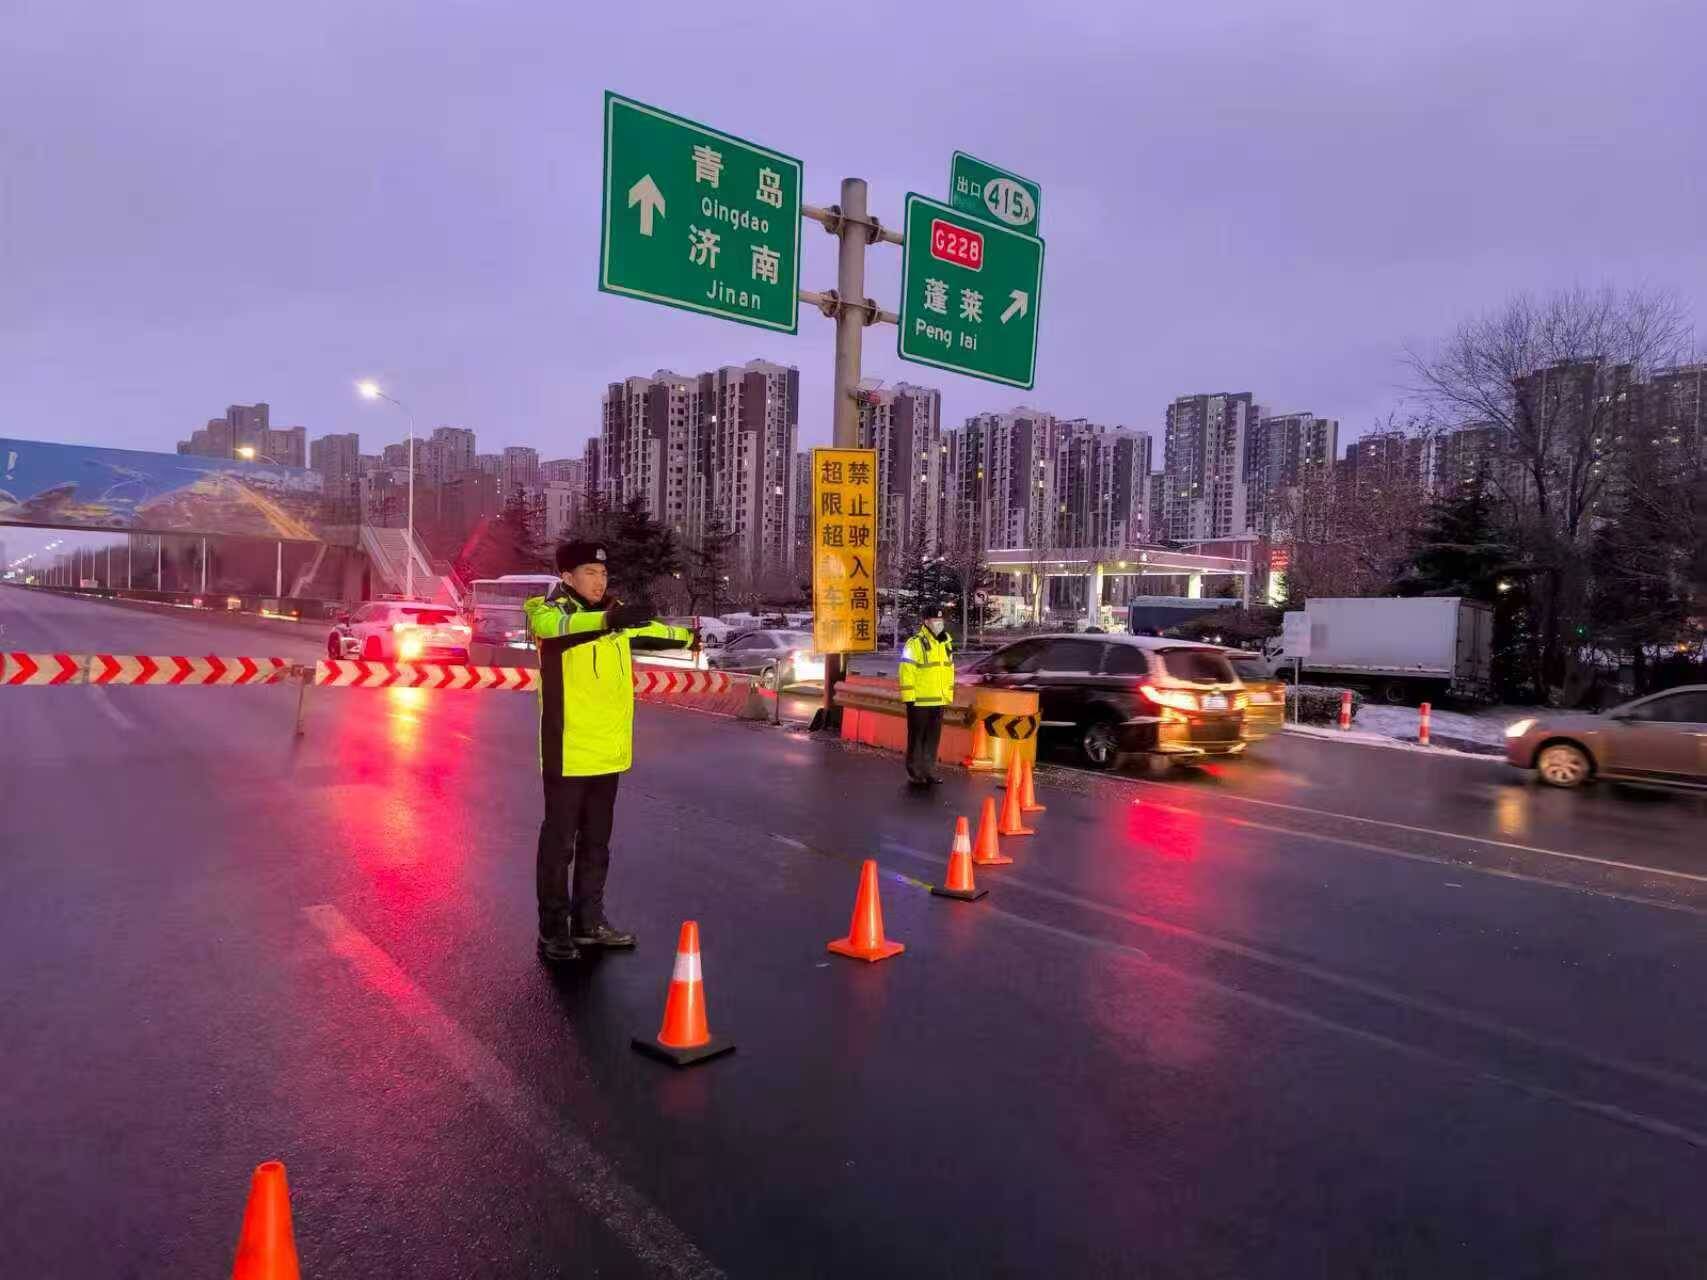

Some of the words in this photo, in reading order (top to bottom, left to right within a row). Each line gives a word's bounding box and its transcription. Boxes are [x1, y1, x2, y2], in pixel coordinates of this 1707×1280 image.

[691, 144, 784, 209] 青岛
[956, 175, 982, 199] 出口
[701, 197, 769, 234] Qingdao
[988, 183, 1031, 222] 415A
[688, 224, 781, 286] 济南
[935, 229, 980, 262] G228
[706, 280, 762, 310] Jinan
[924, 277, 984, 324] 蓬莱
[915, 318, 953, 349] Peng
[959, 332, 978, 351] lai
[820, 460, 845, 643] 超限超车
[847, 460, 871, 641] 禁止驶入高速
